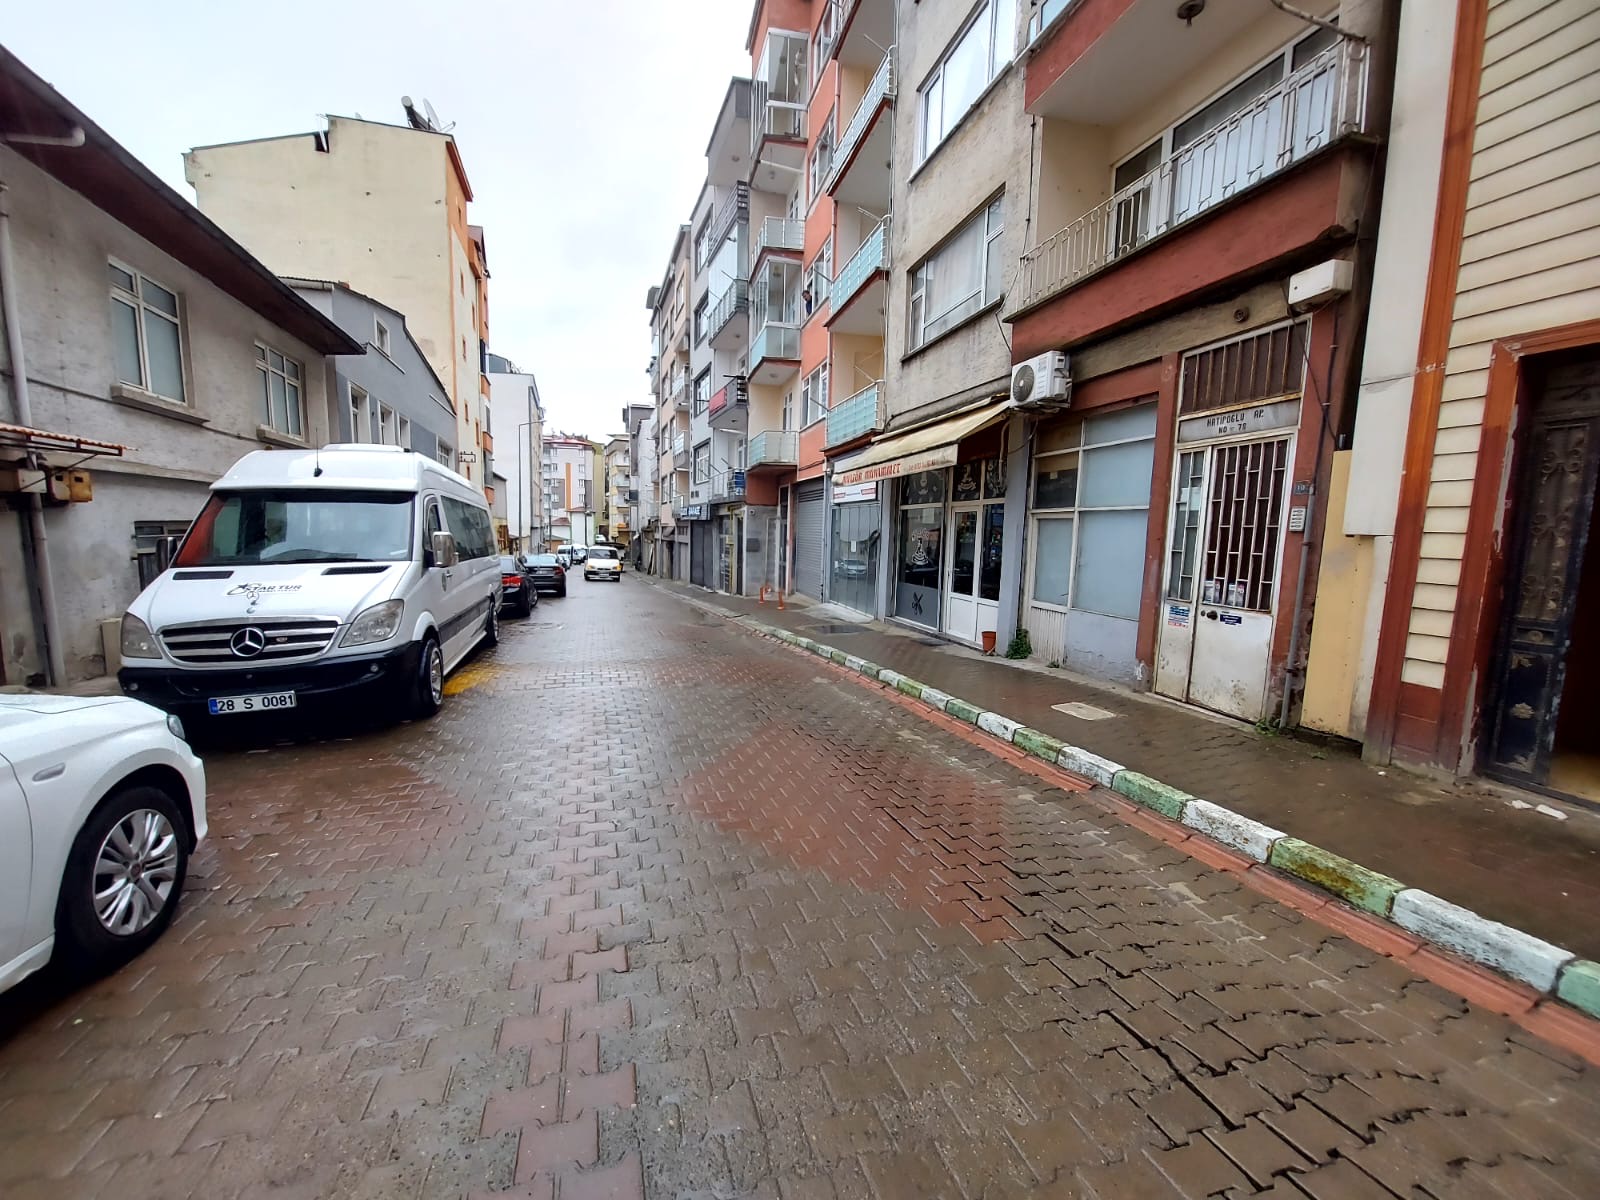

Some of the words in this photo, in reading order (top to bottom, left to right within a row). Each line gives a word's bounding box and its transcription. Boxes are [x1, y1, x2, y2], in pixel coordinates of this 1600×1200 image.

[218, 700, 235, 711] 28
[243, 698, 254, 710] S
[262, 694, 294, 708] 0081
